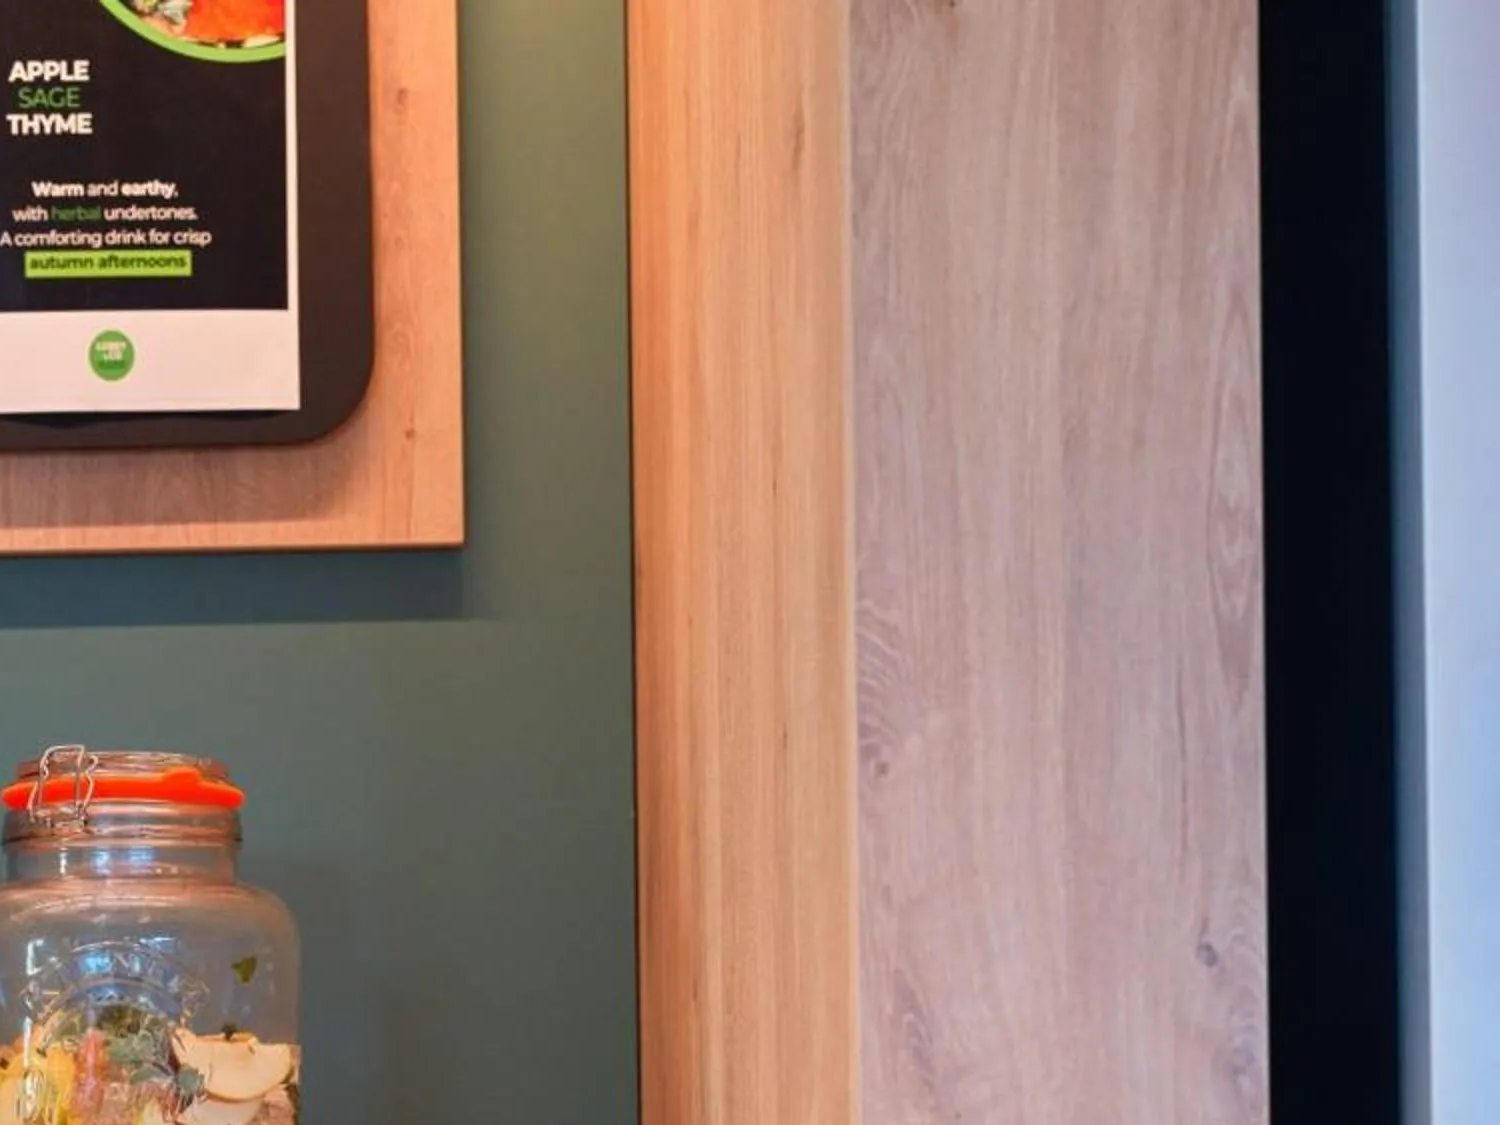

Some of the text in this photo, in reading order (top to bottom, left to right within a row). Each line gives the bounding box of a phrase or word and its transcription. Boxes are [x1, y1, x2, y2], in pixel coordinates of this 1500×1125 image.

[8, 60, 90, 82] APPLE
[18, 86, 80, 108] SAGE
[6, 112, 93, 135] THYME
[31, 181, 84, 197] Warm
[87, 180, 118, 196] and
[12, 205, 48, 221] with
[51, 204, 100, 221] herbal
[0, 227, 213, 248] A comforting drink for crisp
[30, 253, 186, 270] autumn afternoons
